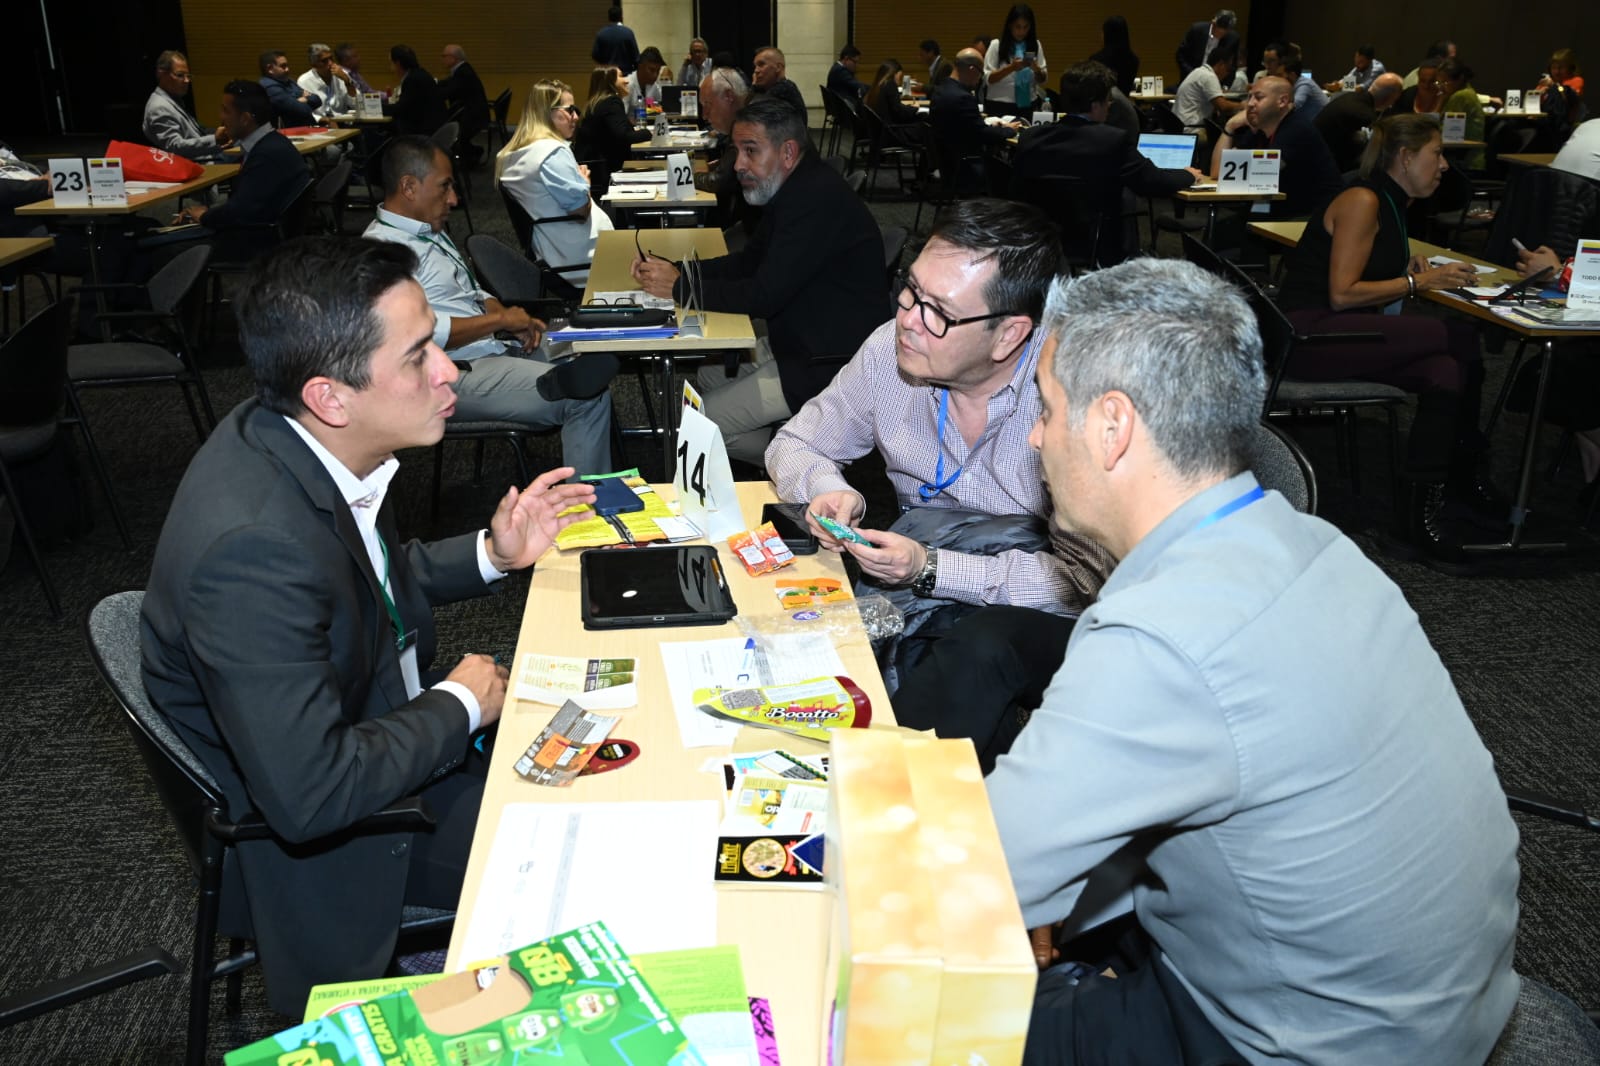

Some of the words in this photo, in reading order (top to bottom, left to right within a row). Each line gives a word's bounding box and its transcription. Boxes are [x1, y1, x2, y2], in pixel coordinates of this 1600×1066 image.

[1508, 96, 1520, 106] 29
[674, 166, 693, 186] 22
[1222, 160, 1249, 181] 21
[53, 171, 84, 192] 23
[677, 440, 707, 507] 14
[765, 706, 840, 719] Bocatto
[361, 1003, 397, 1054] GRATIS
